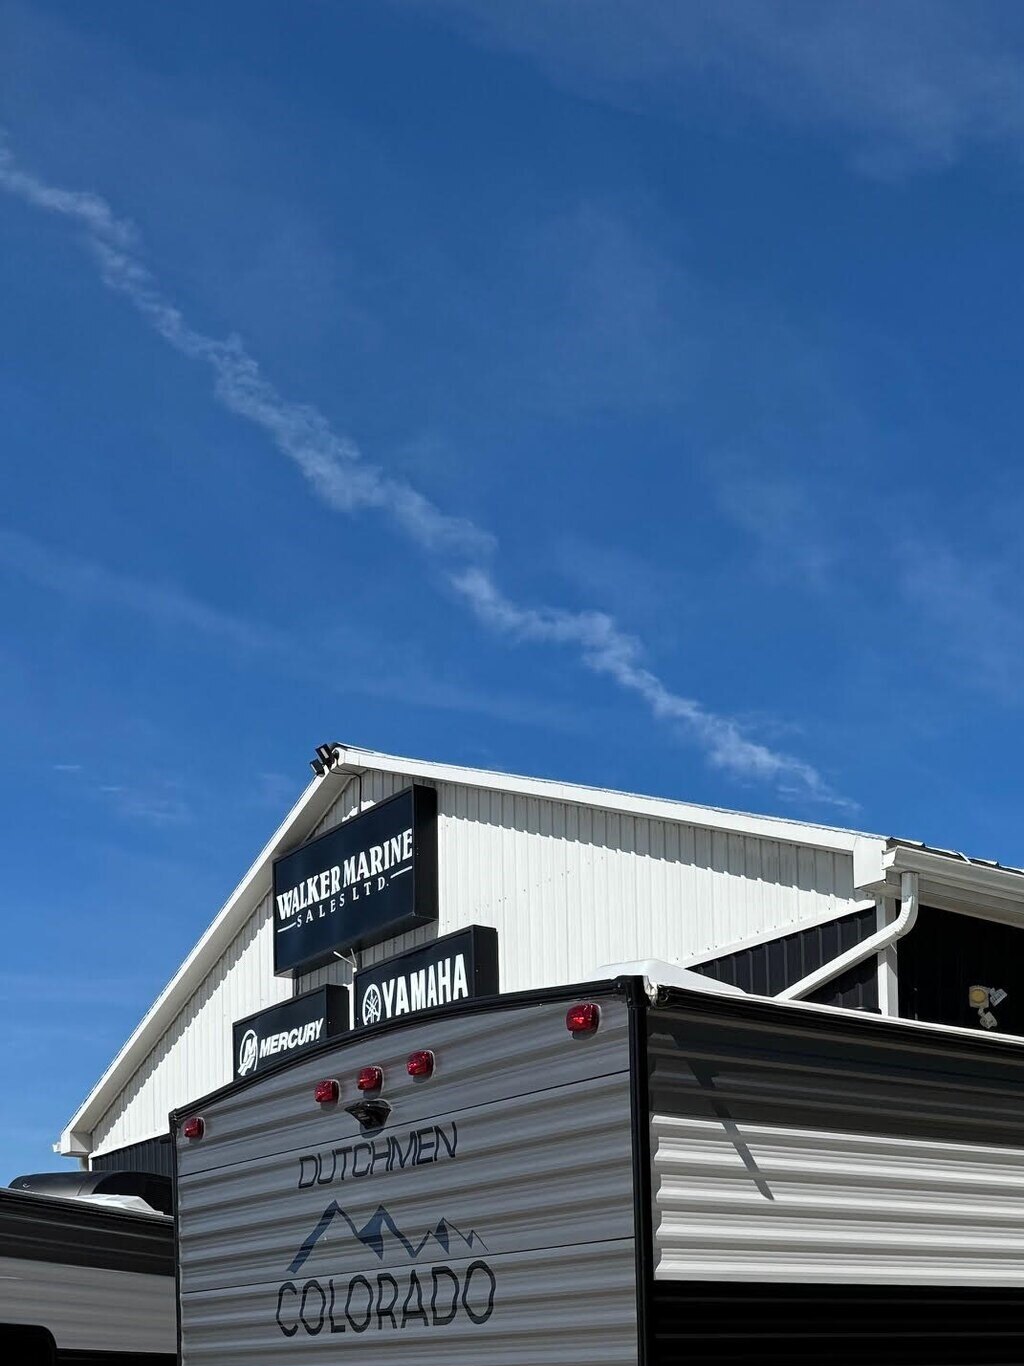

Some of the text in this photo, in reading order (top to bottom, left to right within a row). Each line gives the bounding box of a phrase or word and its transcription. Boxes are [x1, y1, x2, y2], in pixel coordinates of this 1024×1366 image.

[276, 828, 413, 920] WALKER MARINE
[296, 876, 390, 928] SALES LTD.
[381, 953, 469, 1019] YAMAHA
[259, 1018, 324, 1059] MERCURY
[298, 1121, 458, 1189] DUTCHMEN
[276, 1260, 496, 1337] COLORADO
